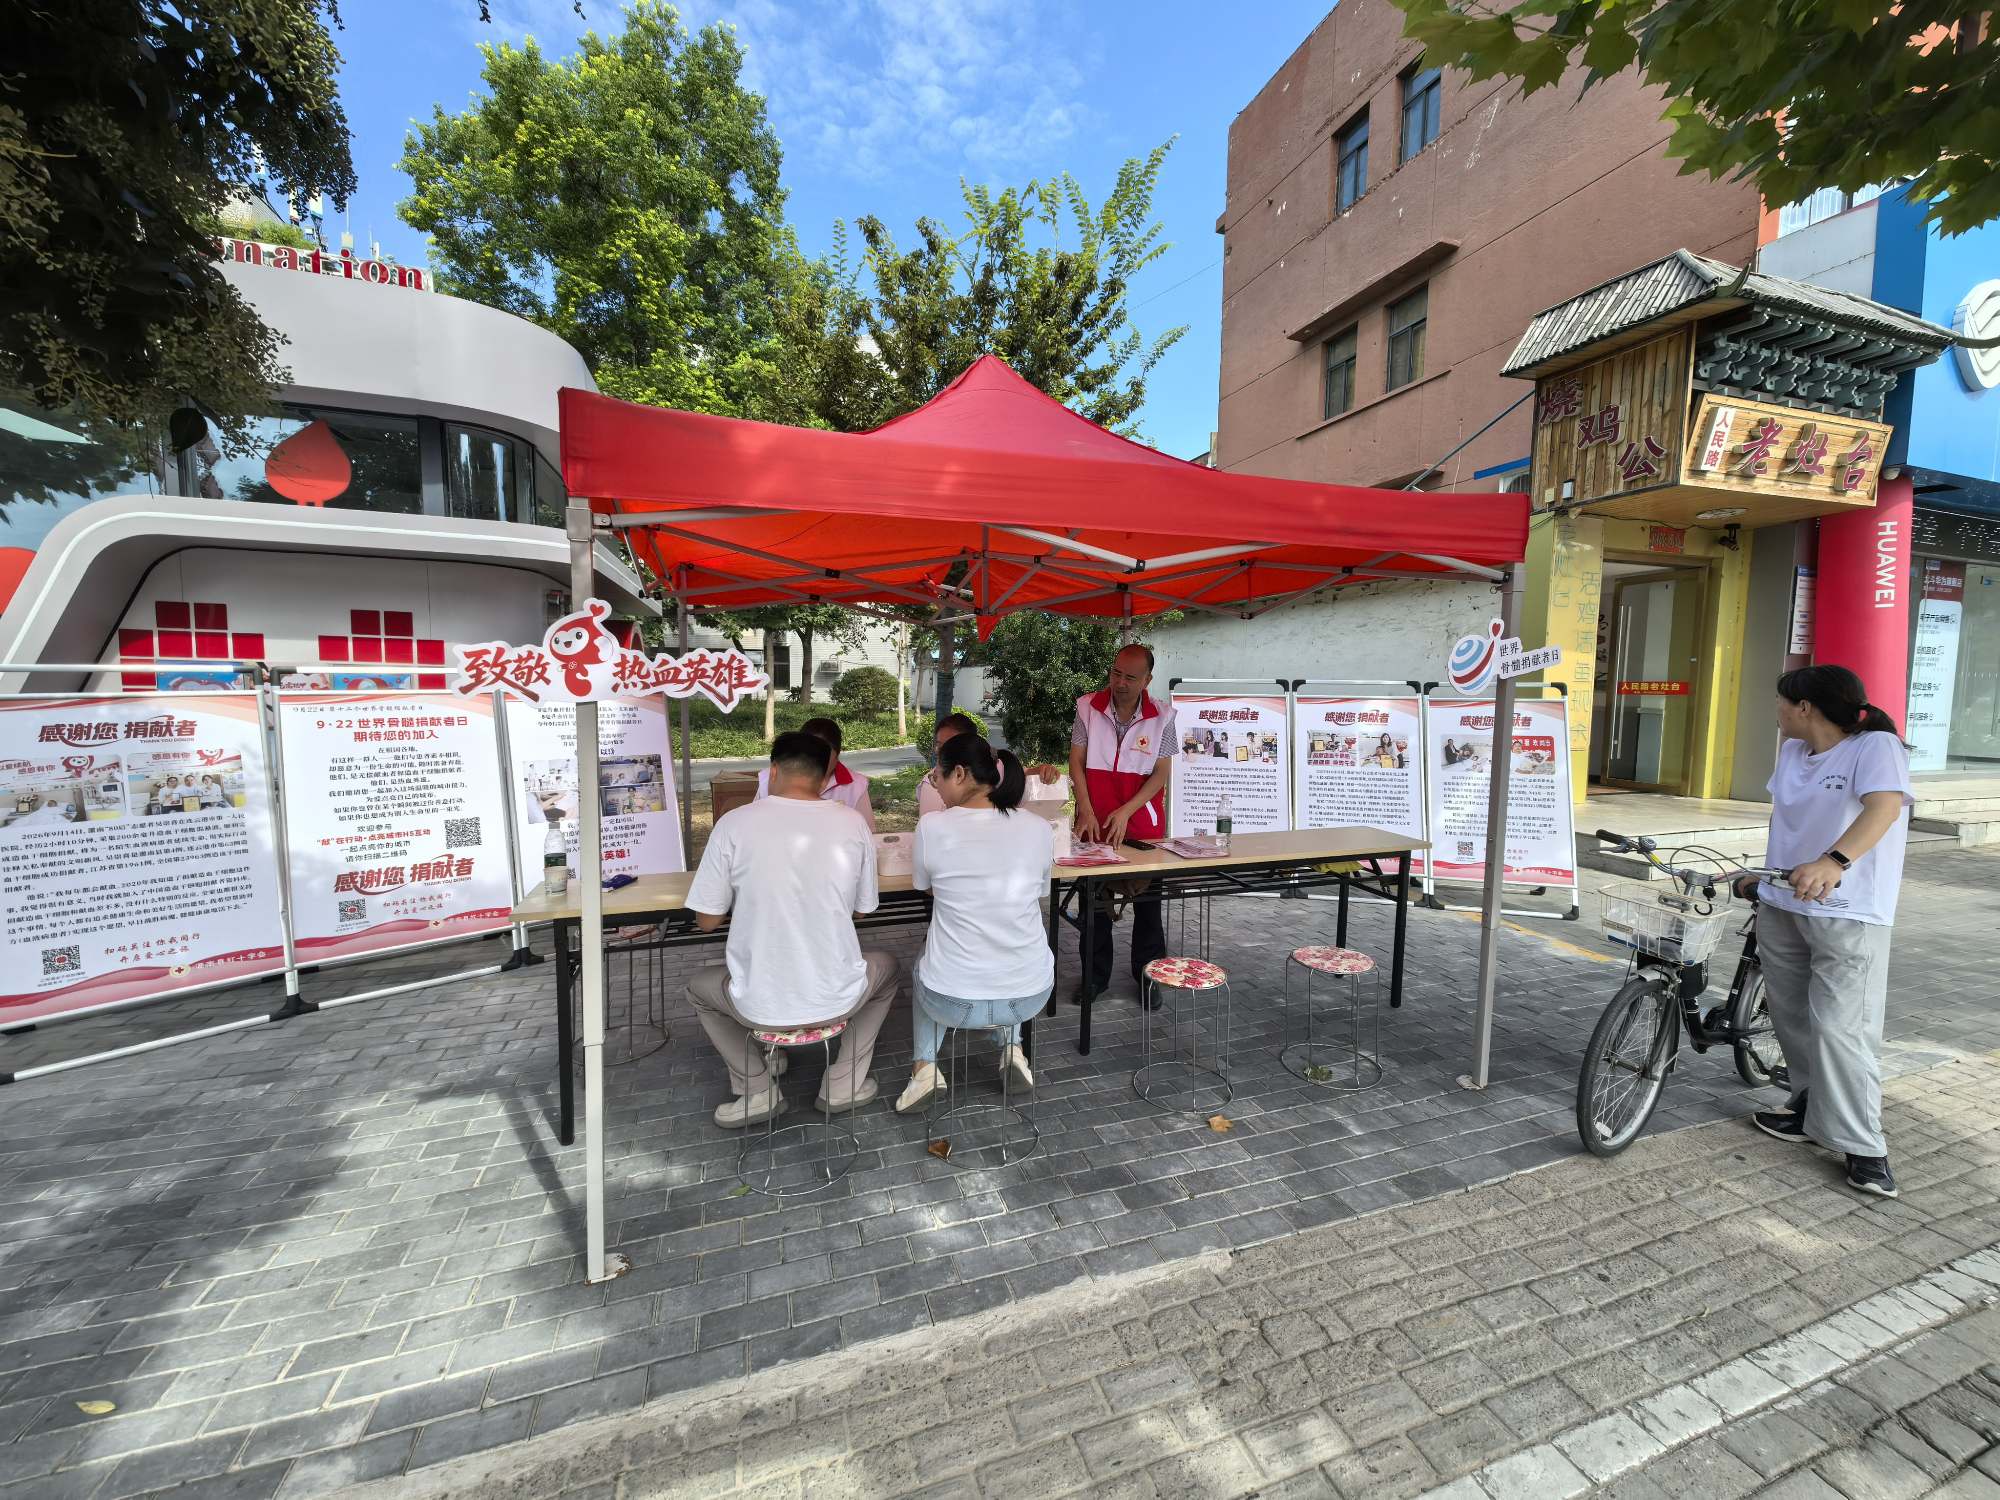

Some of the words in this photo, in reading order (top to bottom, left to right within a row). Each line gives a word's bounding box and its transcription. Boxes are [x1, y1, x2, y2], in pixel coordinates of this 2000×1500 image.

[1538, 377, 1667, 484] 烧鸡公
[1702, 408, 1732, 472] 人民路
[1736, 416, 1875, 492] 老灶台
[1874, 520, 1899, 609] HUAWEI
[1499, 641, 1520, 657] 世界
[1500, 649, 1560, 675] 骨髓捐献者日
[458, 646, 552, 702] 致敬
[610, 651, 762, 706] 热血英雄
[1621, 682, 1681, 691] 人民路老灶台
[357, 716, 468, 729] 世界骨髓捐献者日
[1198, 709, 1228, 720] 感谢您
[1230, 709, 1259, 721] 捐献者
[1324, 711, 1355, 722] 感谢您
[1358, 711, 1390, 723] 捐献者
[38, 721, 118, 743] 感谢您
[124, 719, 197, 739] 捐献者
[353, 729, 439, 742] 期待您的加入
[600, 848, 631, 860] 英雄！
[334, 866, 405, 893] 感谢您
[410, 857, 475, 882] 捐献者
